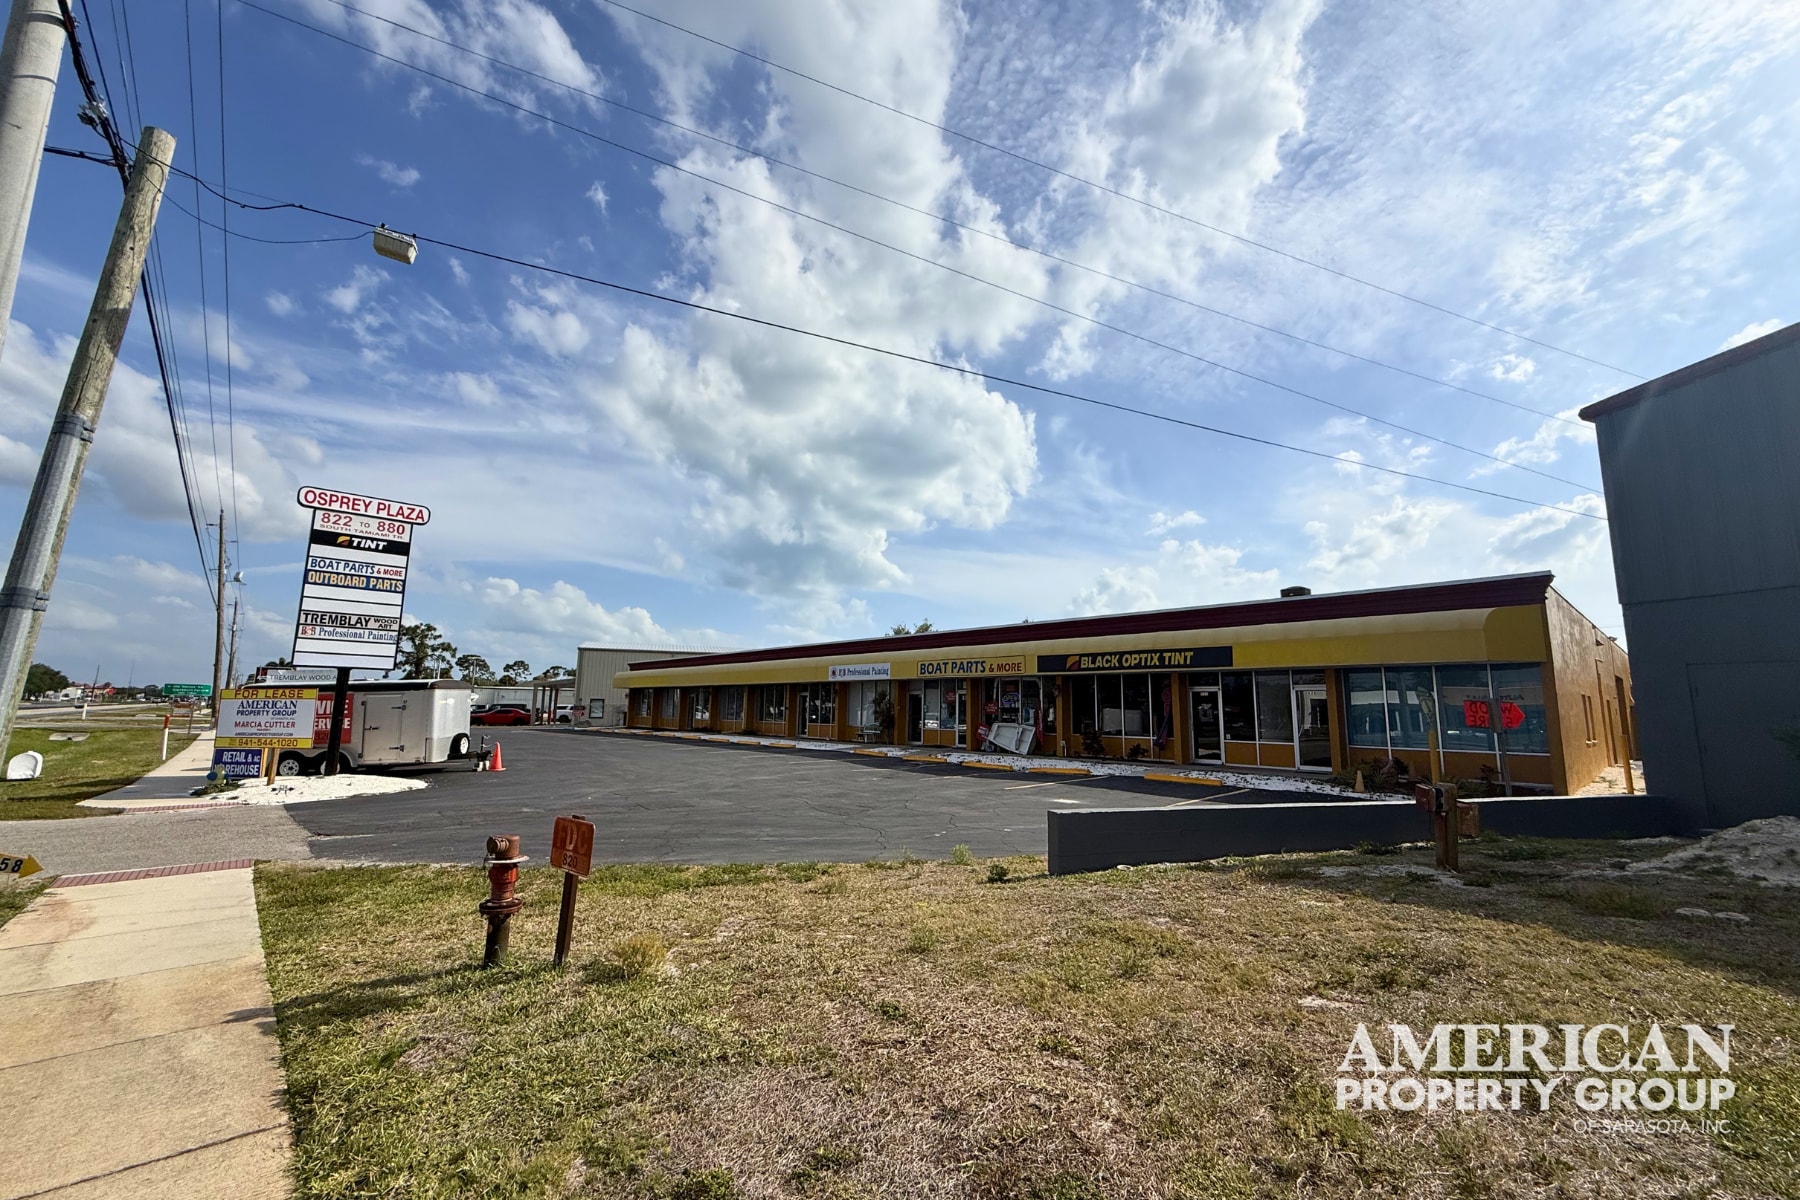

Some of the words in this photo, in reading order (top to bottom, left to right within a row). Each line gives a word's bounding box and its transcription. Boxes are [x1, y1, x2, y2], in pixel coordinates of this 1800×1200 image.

[304, 489, 372, 513] OSPREY
[376, 501, 425, 522] PLAZA
[320, 523, 351, 532] SOUTH
[354, 528, 390, 538] TAMIAMI
[321, 512, 353, 527] 822
[376, 521, 405, 535] 880
[351, 538, 387, 550] TINT
[310, 558, 341, 571] BOAT
[343, 562, 376, 575] PARTS
[383, 569, 403, 577] MORE
[308, 571, 366, 588] OUTBOARD
[369, 578, 403, 591] PARTS
[303, 612, 371, 627] TREMBLAY
[373, 617, 398, 625] WOOD
[318, 627, 366, 640] Professional
[367, 630, 400, 643] Painting
[1080, 655, 1120, 668] BLACK
[1121, 653, 1160, 666] OPTIX
[1162, 651, 1194, 665] TINT
[847, 667, 871, 676] Professional
[871, 666, 889, 676] Painting
[920, 662, 949, 675] BOAT
[950, 661, 987, 674] PARTS
[988, 663, 995, 673] &
[996, 662, 1022, 672] MORE
[234, 689, 260, 699] FOR
[264, 689, 305, 698] LEASE
[237, 700, 298, 710] AMERICAN
[236, 709, 270, 717] PROPERTY
[271, 709, 297, 717] GROUP
[238, 738, 298, 748] 941-544-1020
[222, 751, 247, 763] RETAIL
[247, 754, 253, 762] &
[0, 858, 23, 873] 58
[562, 853, 578, 868] 820
